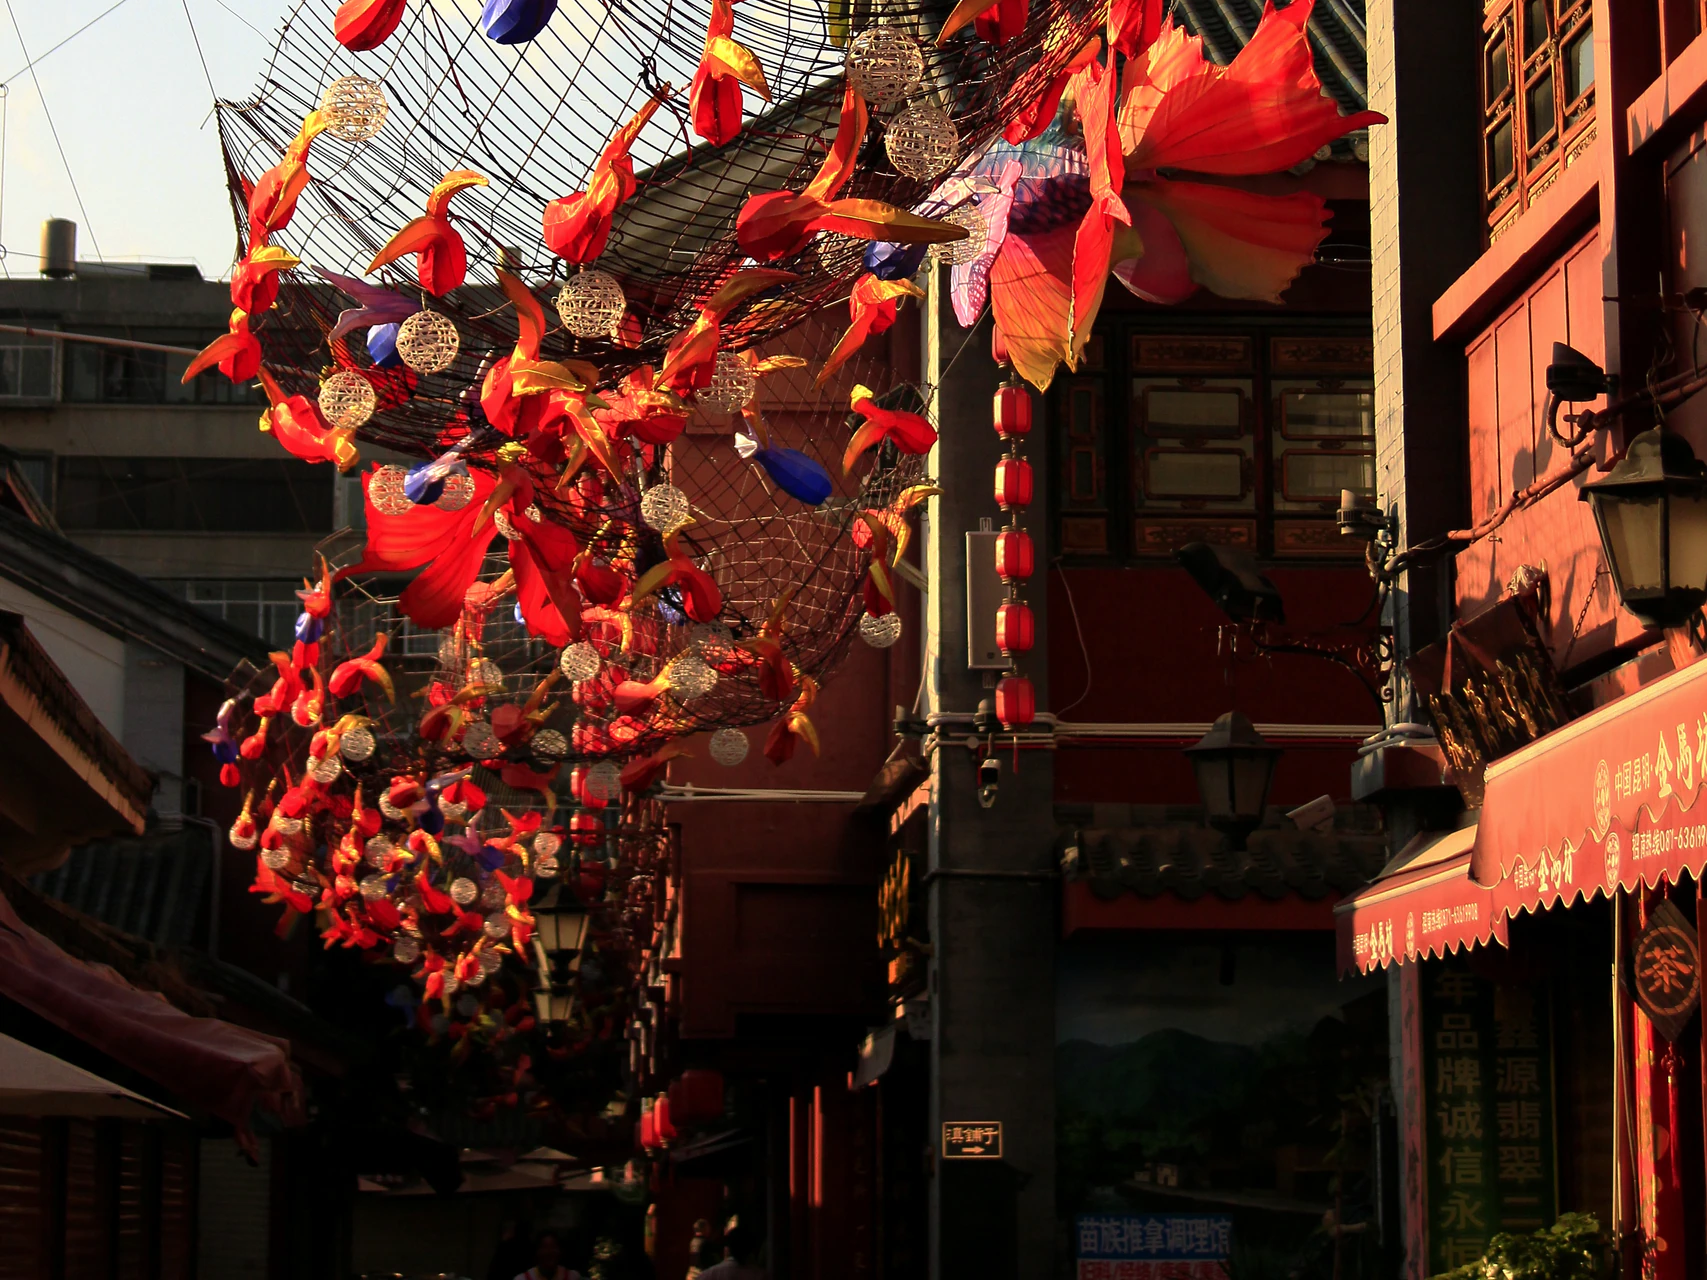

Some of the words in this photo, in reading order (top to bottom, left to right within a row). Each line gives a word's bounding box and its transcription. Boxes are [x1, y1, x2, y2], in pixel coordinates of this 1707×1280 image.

[1632, 824, 1707, 860] 招商热线0871-636199
[1640, 945, 1693, 993] 茶
[1432, 968, 1486, 1269] 年品牌诚信永恒
[1078, 1217, 1232, 1254] 苗族推拿调理馆
